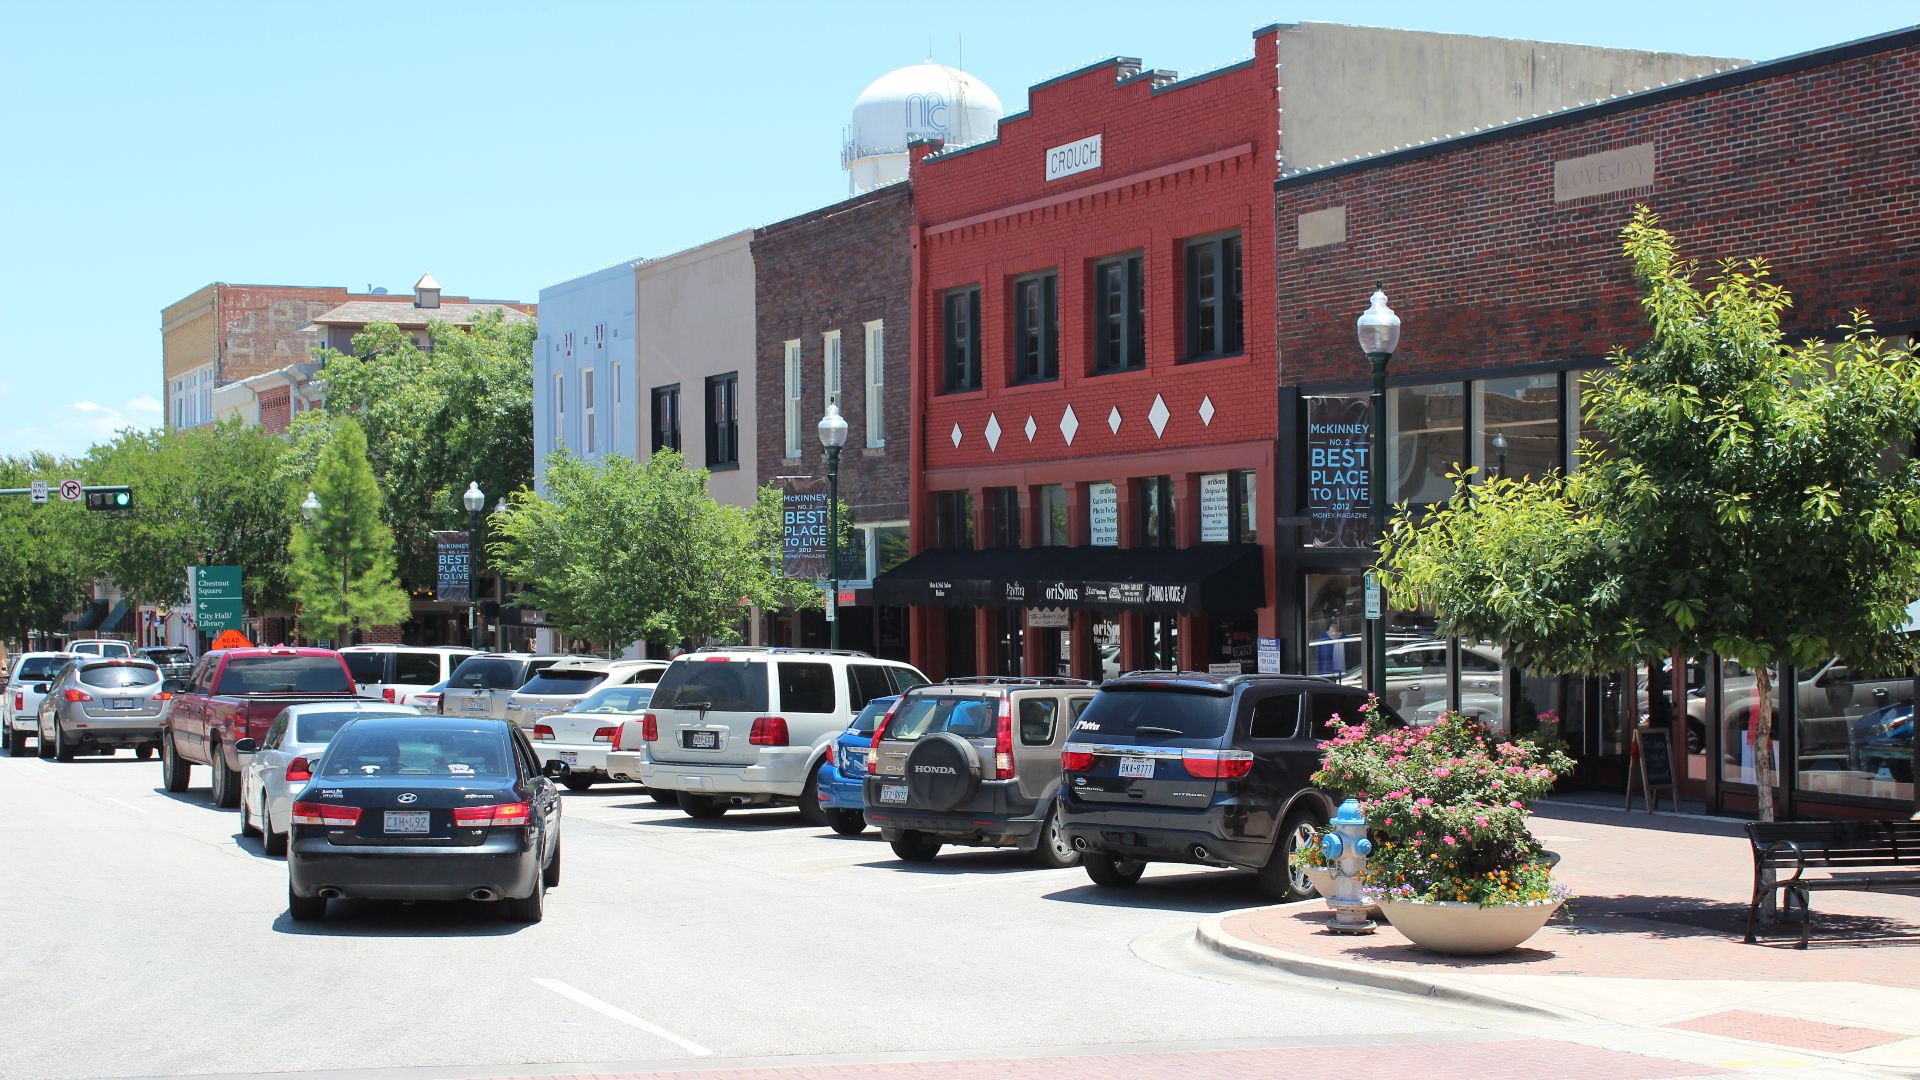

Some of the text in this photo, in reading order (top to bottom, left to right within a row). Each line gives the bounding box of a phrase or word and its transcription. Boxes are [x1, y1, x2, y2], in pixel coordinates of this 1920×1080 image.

[1051, 140, 1098, 174] CROUCH
[1561, 158, 1645, 190] LOVEJOY
[1310, 424, 1370, 434] McKINNEY
[1312, 448, 1368, 468] BEST
[1311, 470, 1368, 485] PLACE
[784, 494, 827, 502] McKINNEY
[1311, 488, 1368, 500] TO LIVE
[784, 510, 826, 524] BEST
[784, 526, 826, 536] PLACE
[784, 538, 826, 546] TO LIVE
[439, 555, 468, 564] BEST
[1046, 582, 1078, 600] oriSons
[1151, 586, 1164, 601] PIANO
[1168, 586, 1181, 601] VOICE
[914, 765, 956, 775] HONDA
